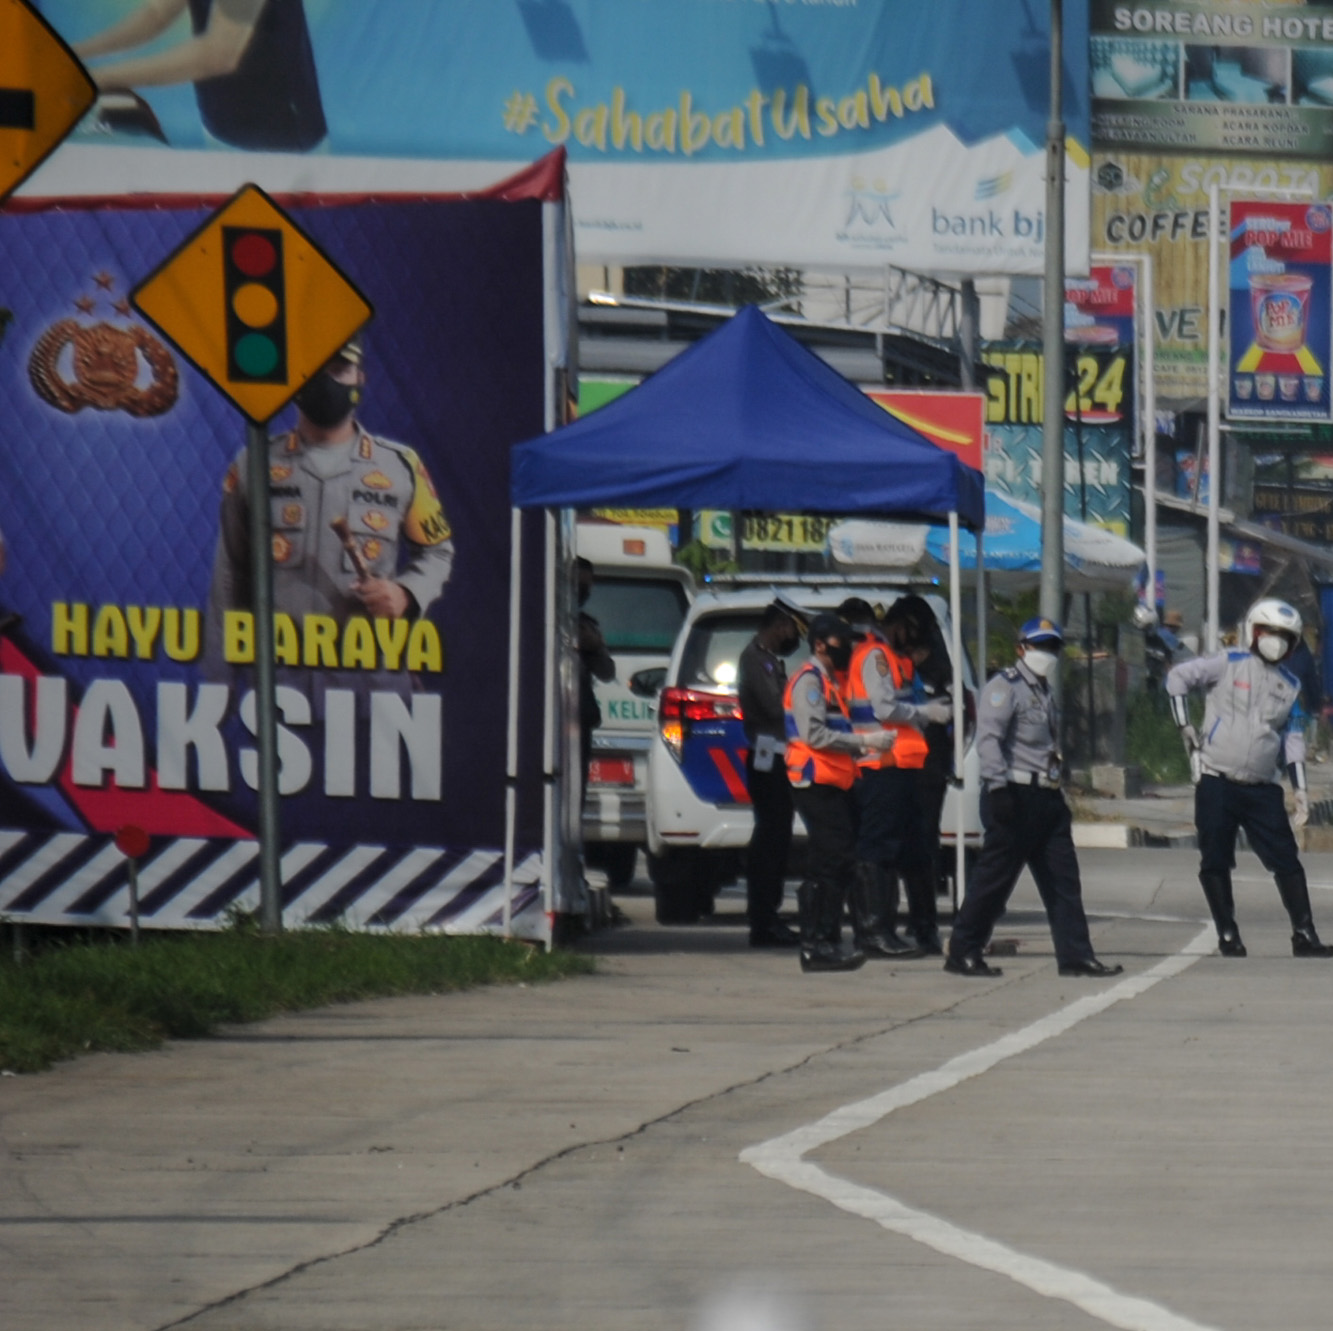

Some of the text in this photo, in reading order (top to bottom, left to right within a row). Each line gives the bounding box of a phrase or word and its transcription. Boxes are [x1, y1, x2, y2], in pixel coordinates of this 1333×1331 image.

[1114, 8, 1253, 38] SOREANG
[502, 72, 935, 155] #SahabatUsaha
[929, 206, 1044, 243] bank bj
[1065, 356, 1126, 414] 24
[51, 601, 443, 673] HAYU BARAYA
[0, 672, 442, 801] VAKSIN
